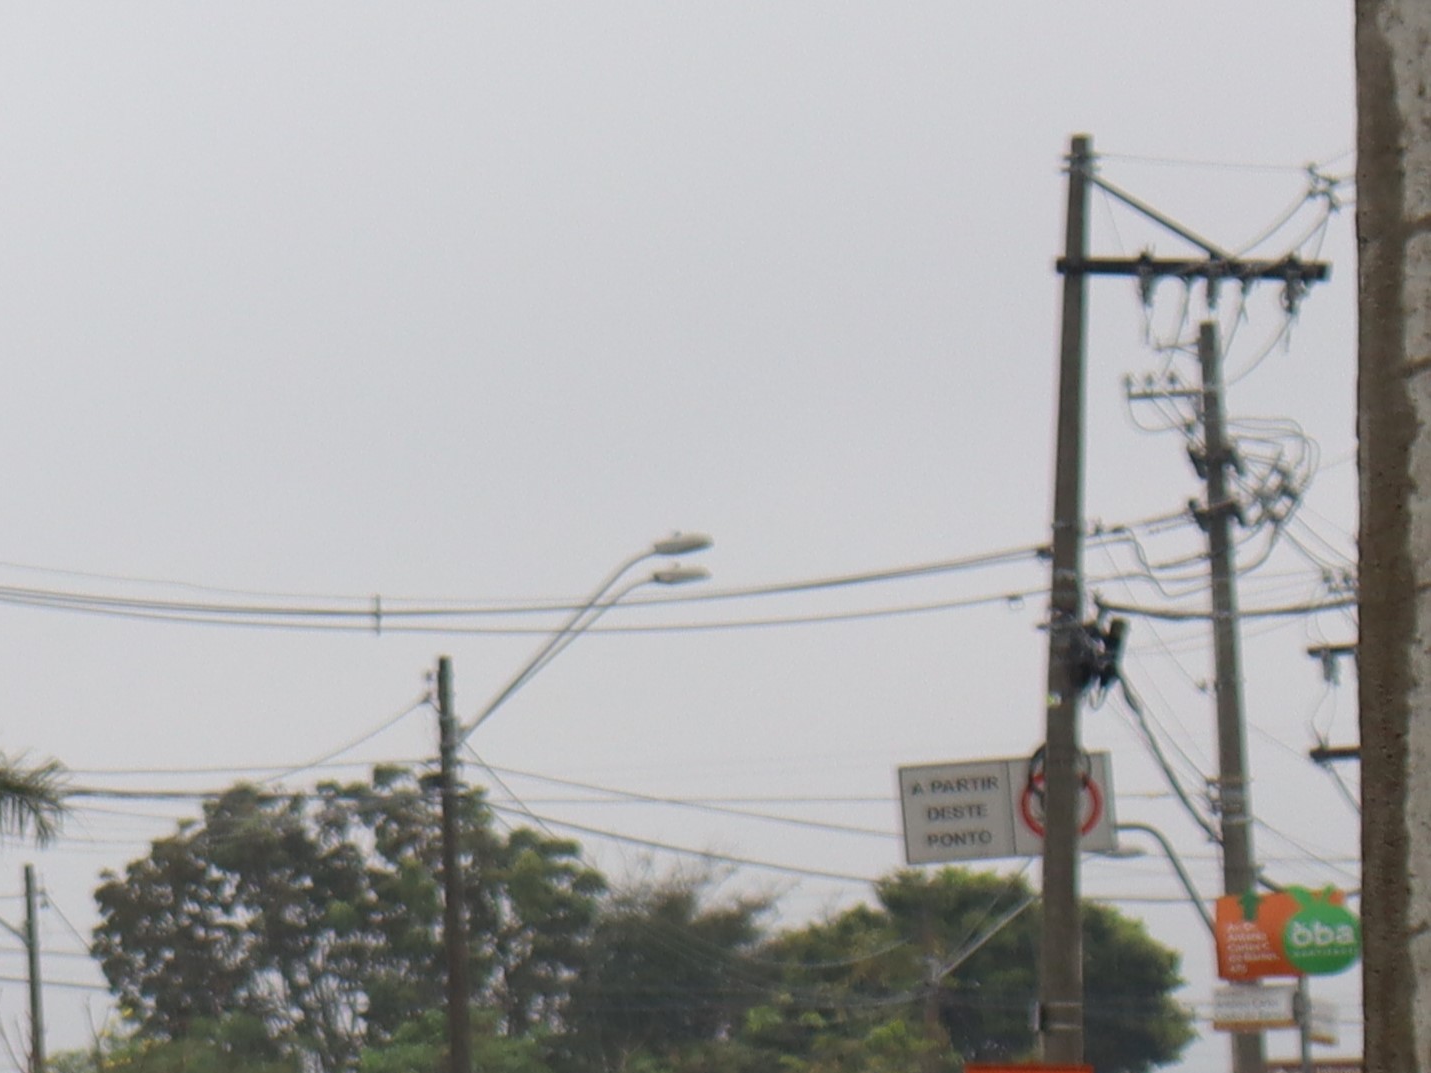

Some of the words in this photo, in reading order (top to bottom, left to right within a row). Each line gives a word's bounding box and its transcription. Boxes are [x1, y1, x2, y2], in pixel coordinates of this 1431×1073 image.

[911, 781, 924, 796] A
[930, 775, 1000, 794] PARTIR
[926, 803, 989, 822] DESTE
[926, 830, 993, 848] PONTO
